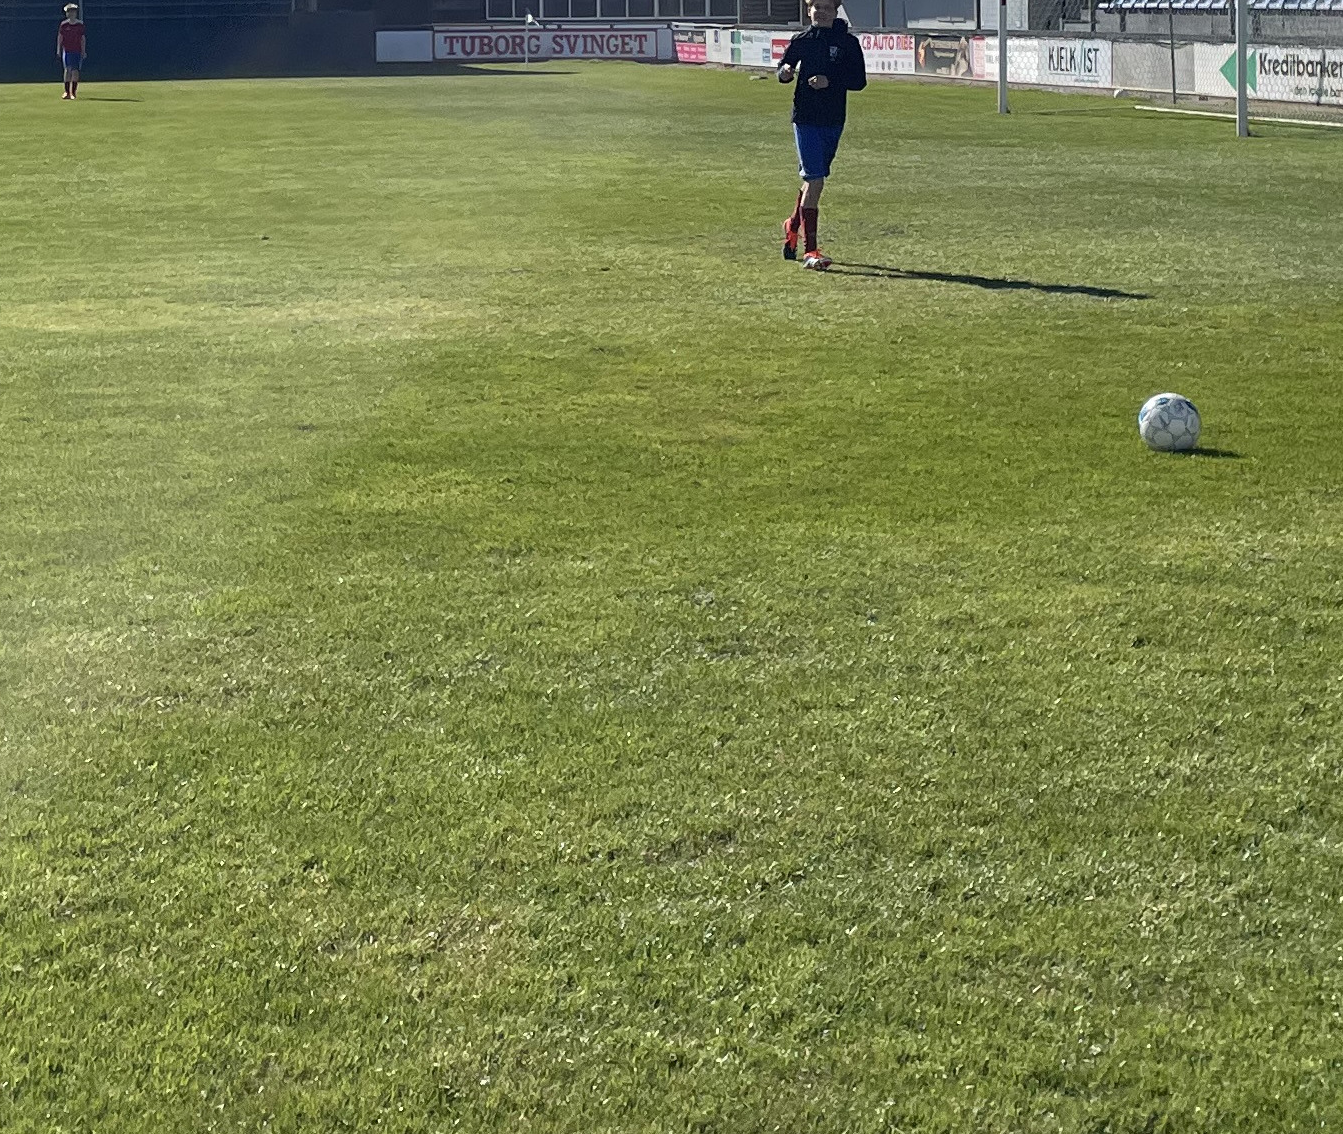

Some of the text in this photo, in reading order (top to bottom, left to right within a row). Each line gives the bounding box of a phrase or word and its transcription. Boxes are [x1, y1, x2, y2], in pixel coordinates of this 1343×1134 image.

[444, 35, 542, 56] TUBORG
[552, 33, 648, 56] SVINGET
[873, 35, 895, 50] AUTO
